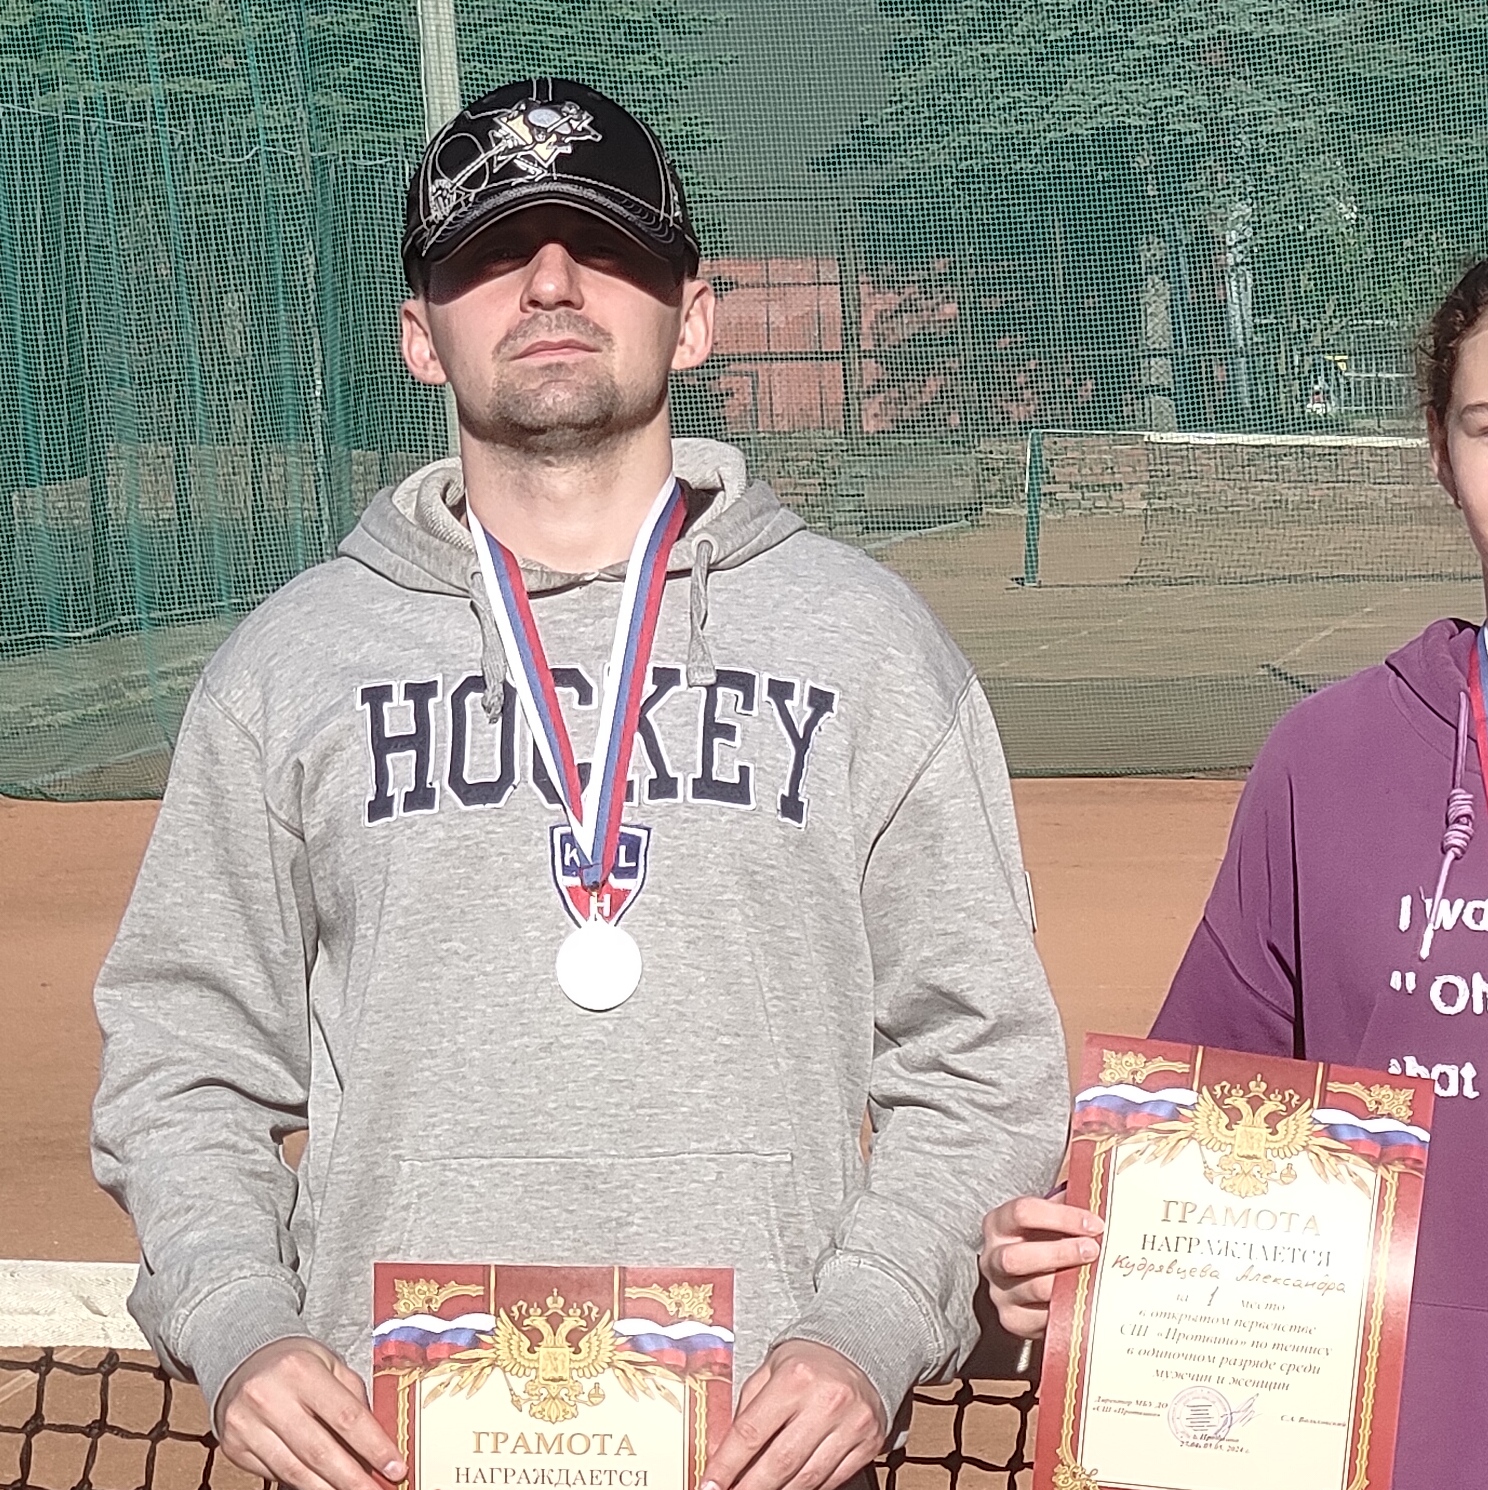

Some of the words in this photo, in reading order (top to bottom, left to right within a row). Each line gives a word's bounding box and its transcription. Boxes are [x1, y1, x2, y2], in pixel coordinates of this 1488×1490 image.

[1161, 1200, 1321, 1236] ГРАМОТА
[1141, 1234, 1331, 1267] НАГРАЖДАЕТСЯ
[1111, 1254, 1220, 1280] Кудрявцева
[1236, 1264, 1346, 1297] Александра
[1207, 1286, 1219, 1307] 1
[1120, 1324, 1149, 1338] СШ
[1150, 1309, 1230, 1326] открытом
[1234, 1316, 1317, 1335] первенстве
[1137, 1347, 1216, 1364] одиночном
[1218, 1353, 1277, 1371] разряде
[1279, 1361, 1321, 1376] среди
[1152, 1368, 1213, 1384] мужчин
[1216, 1375, 1225, 1385] и
[1228, 1376, 1290, 1392] женщин
[472, 1430, 638, 1456] ГРАМОТА
[454, 1466, 649, 1488] НАГРАЖДАЕТСЯ
